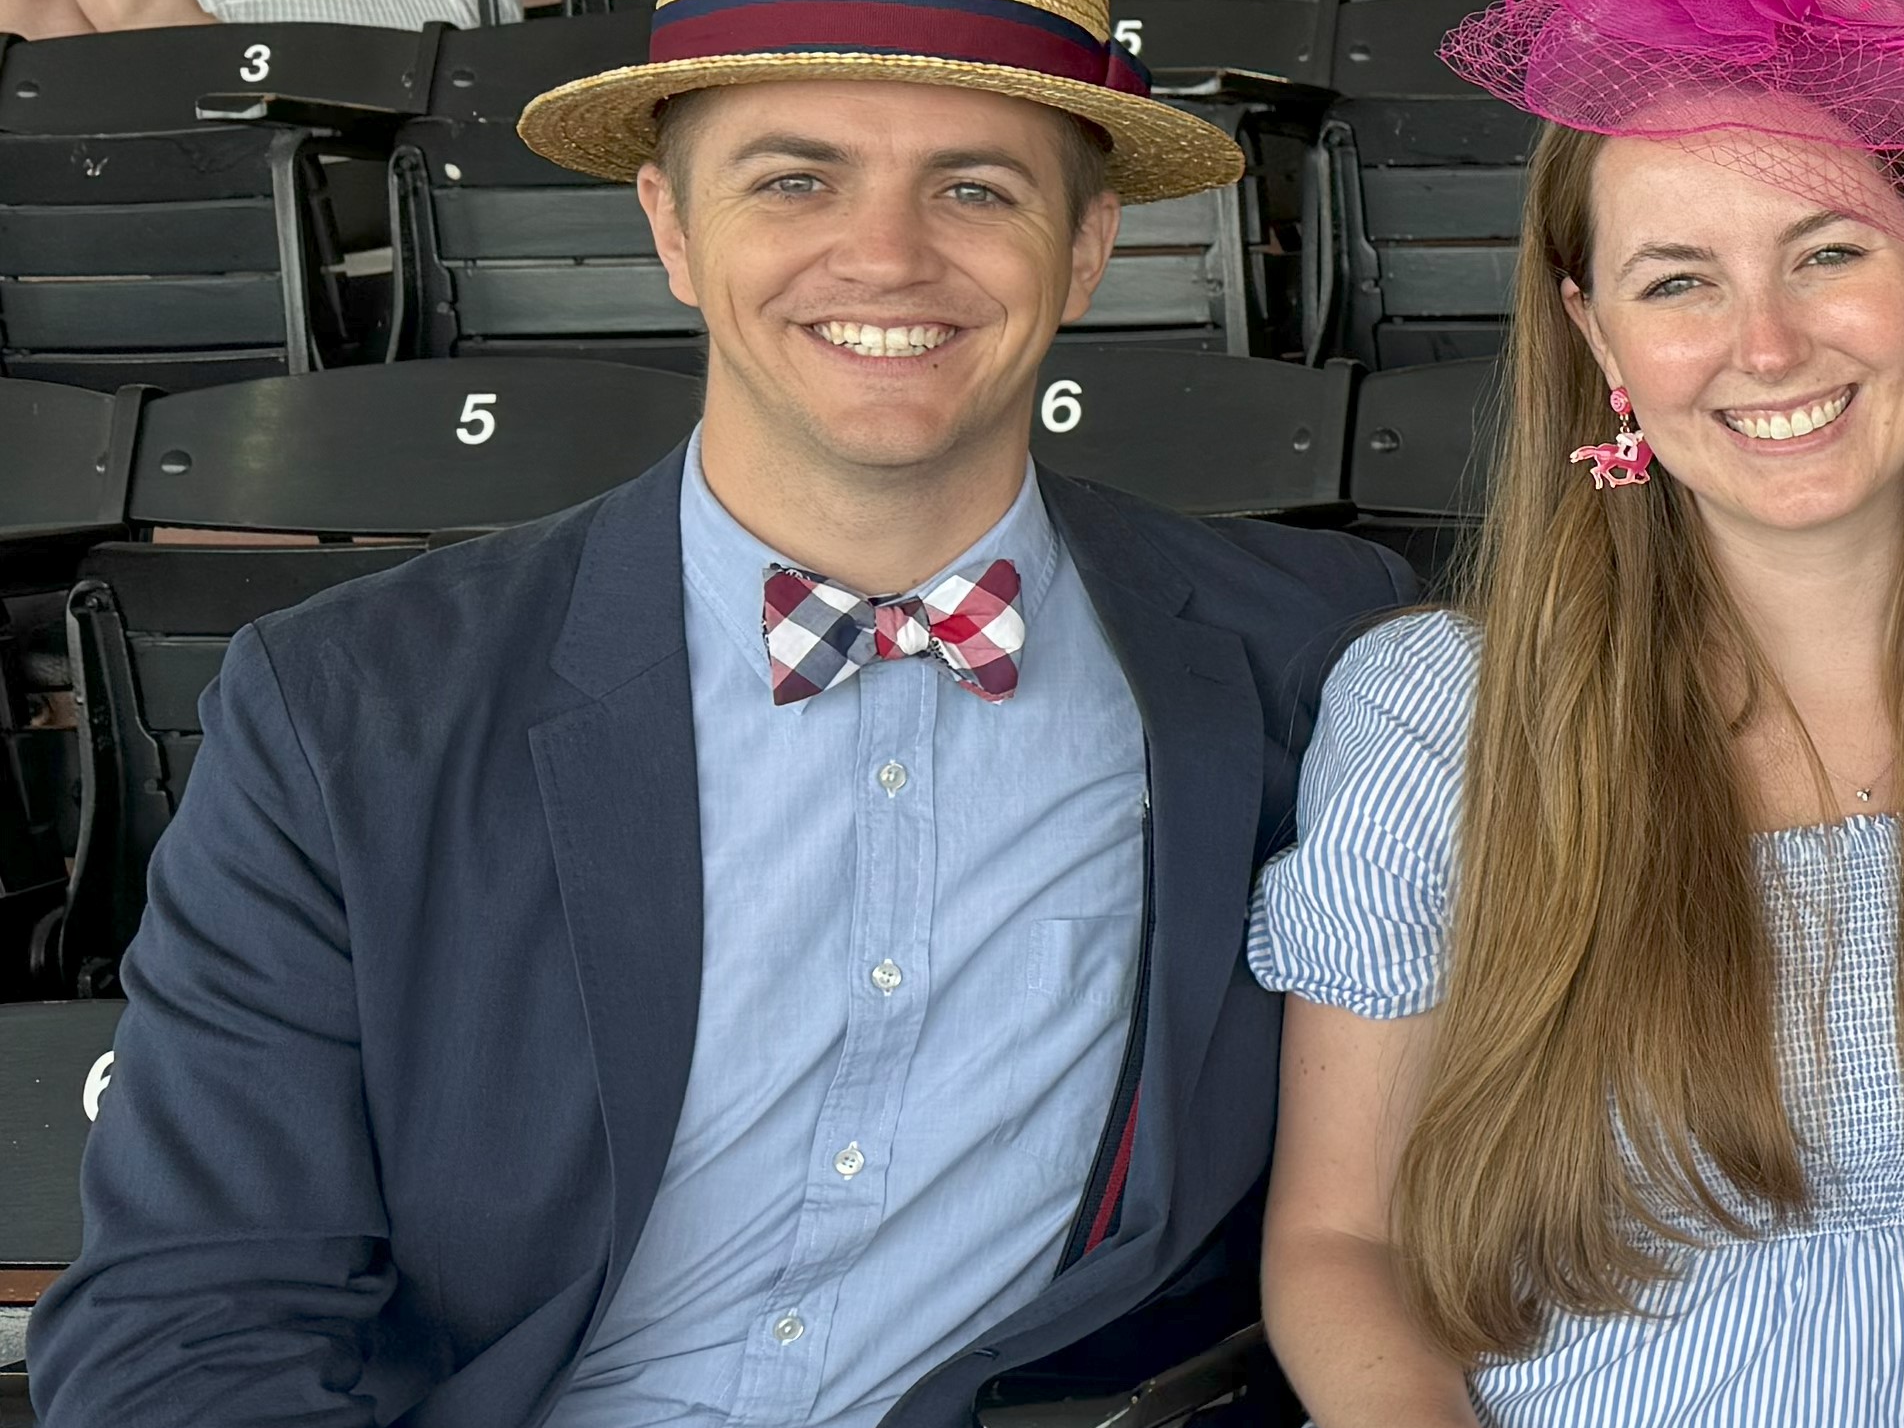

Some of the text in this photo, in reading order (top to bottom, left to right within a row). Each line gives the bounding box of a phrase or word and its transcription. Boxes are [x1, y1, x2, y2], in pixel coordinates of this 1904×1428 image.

[1113, 19, 1143, 56] 5
[239, 43, 272, 83] 3
[455, 393, 497, 445] 5
[1041, 379, 1083, 433] 6
